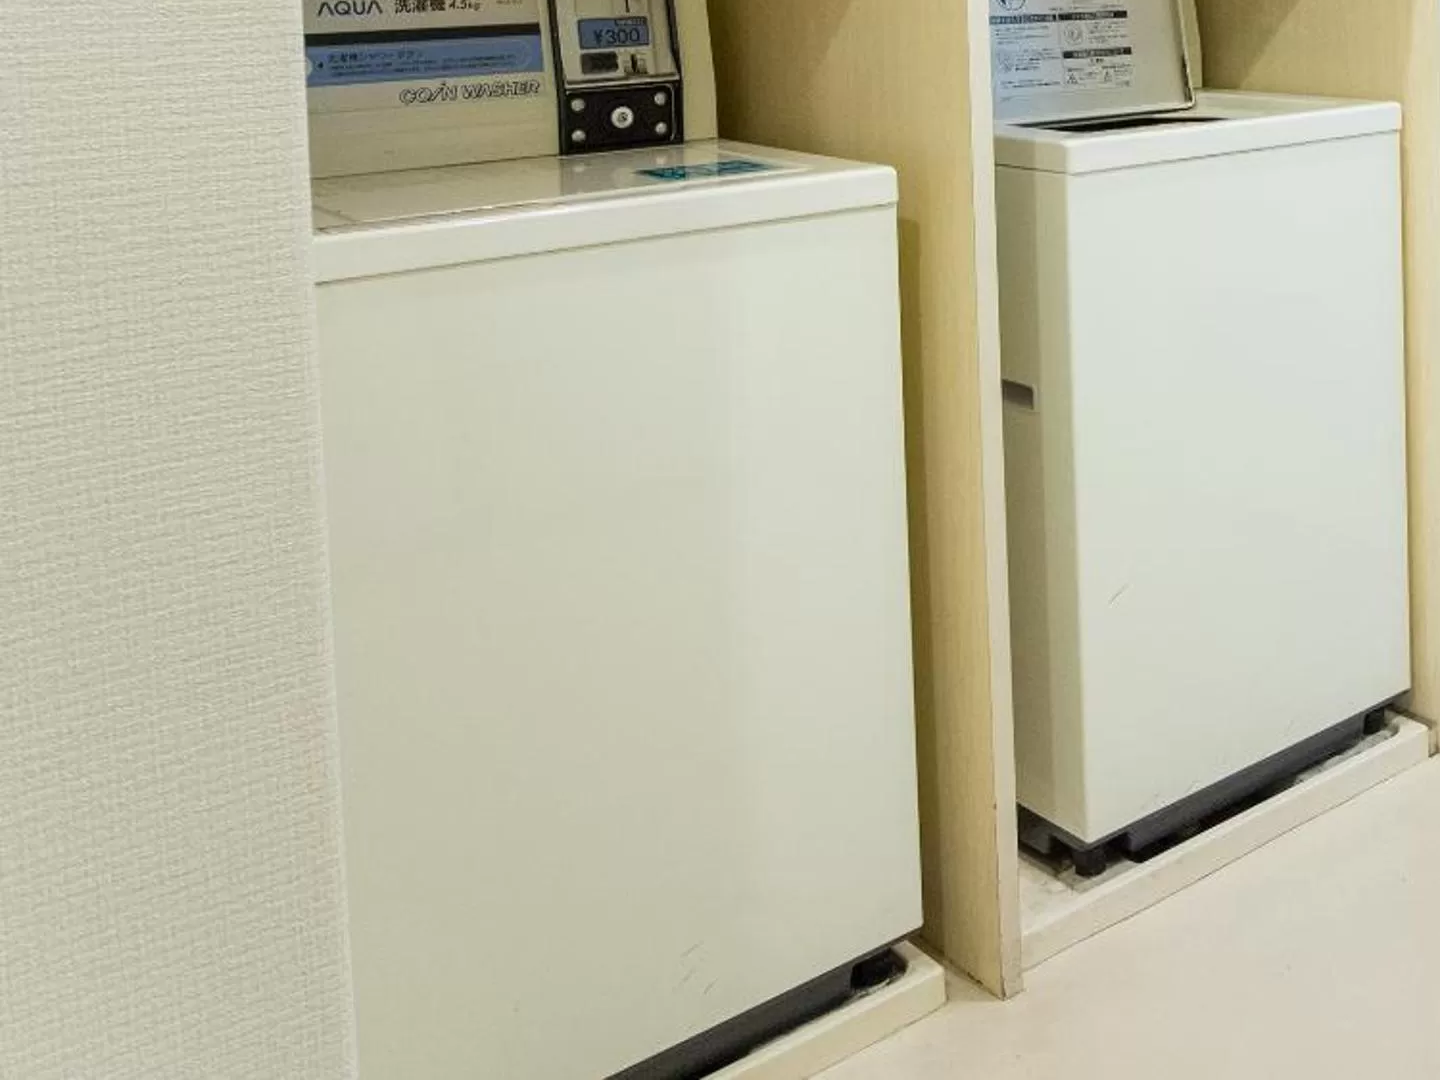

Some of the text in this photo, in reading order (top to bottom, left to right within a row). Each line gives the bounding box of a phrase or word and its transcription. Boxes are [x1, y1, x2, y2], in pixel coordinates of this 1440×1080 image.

[317, 1, 383, 18] AQUA
[594, 29, 641, 46] ¥300
[461, 80, 541, 99] WASHER
